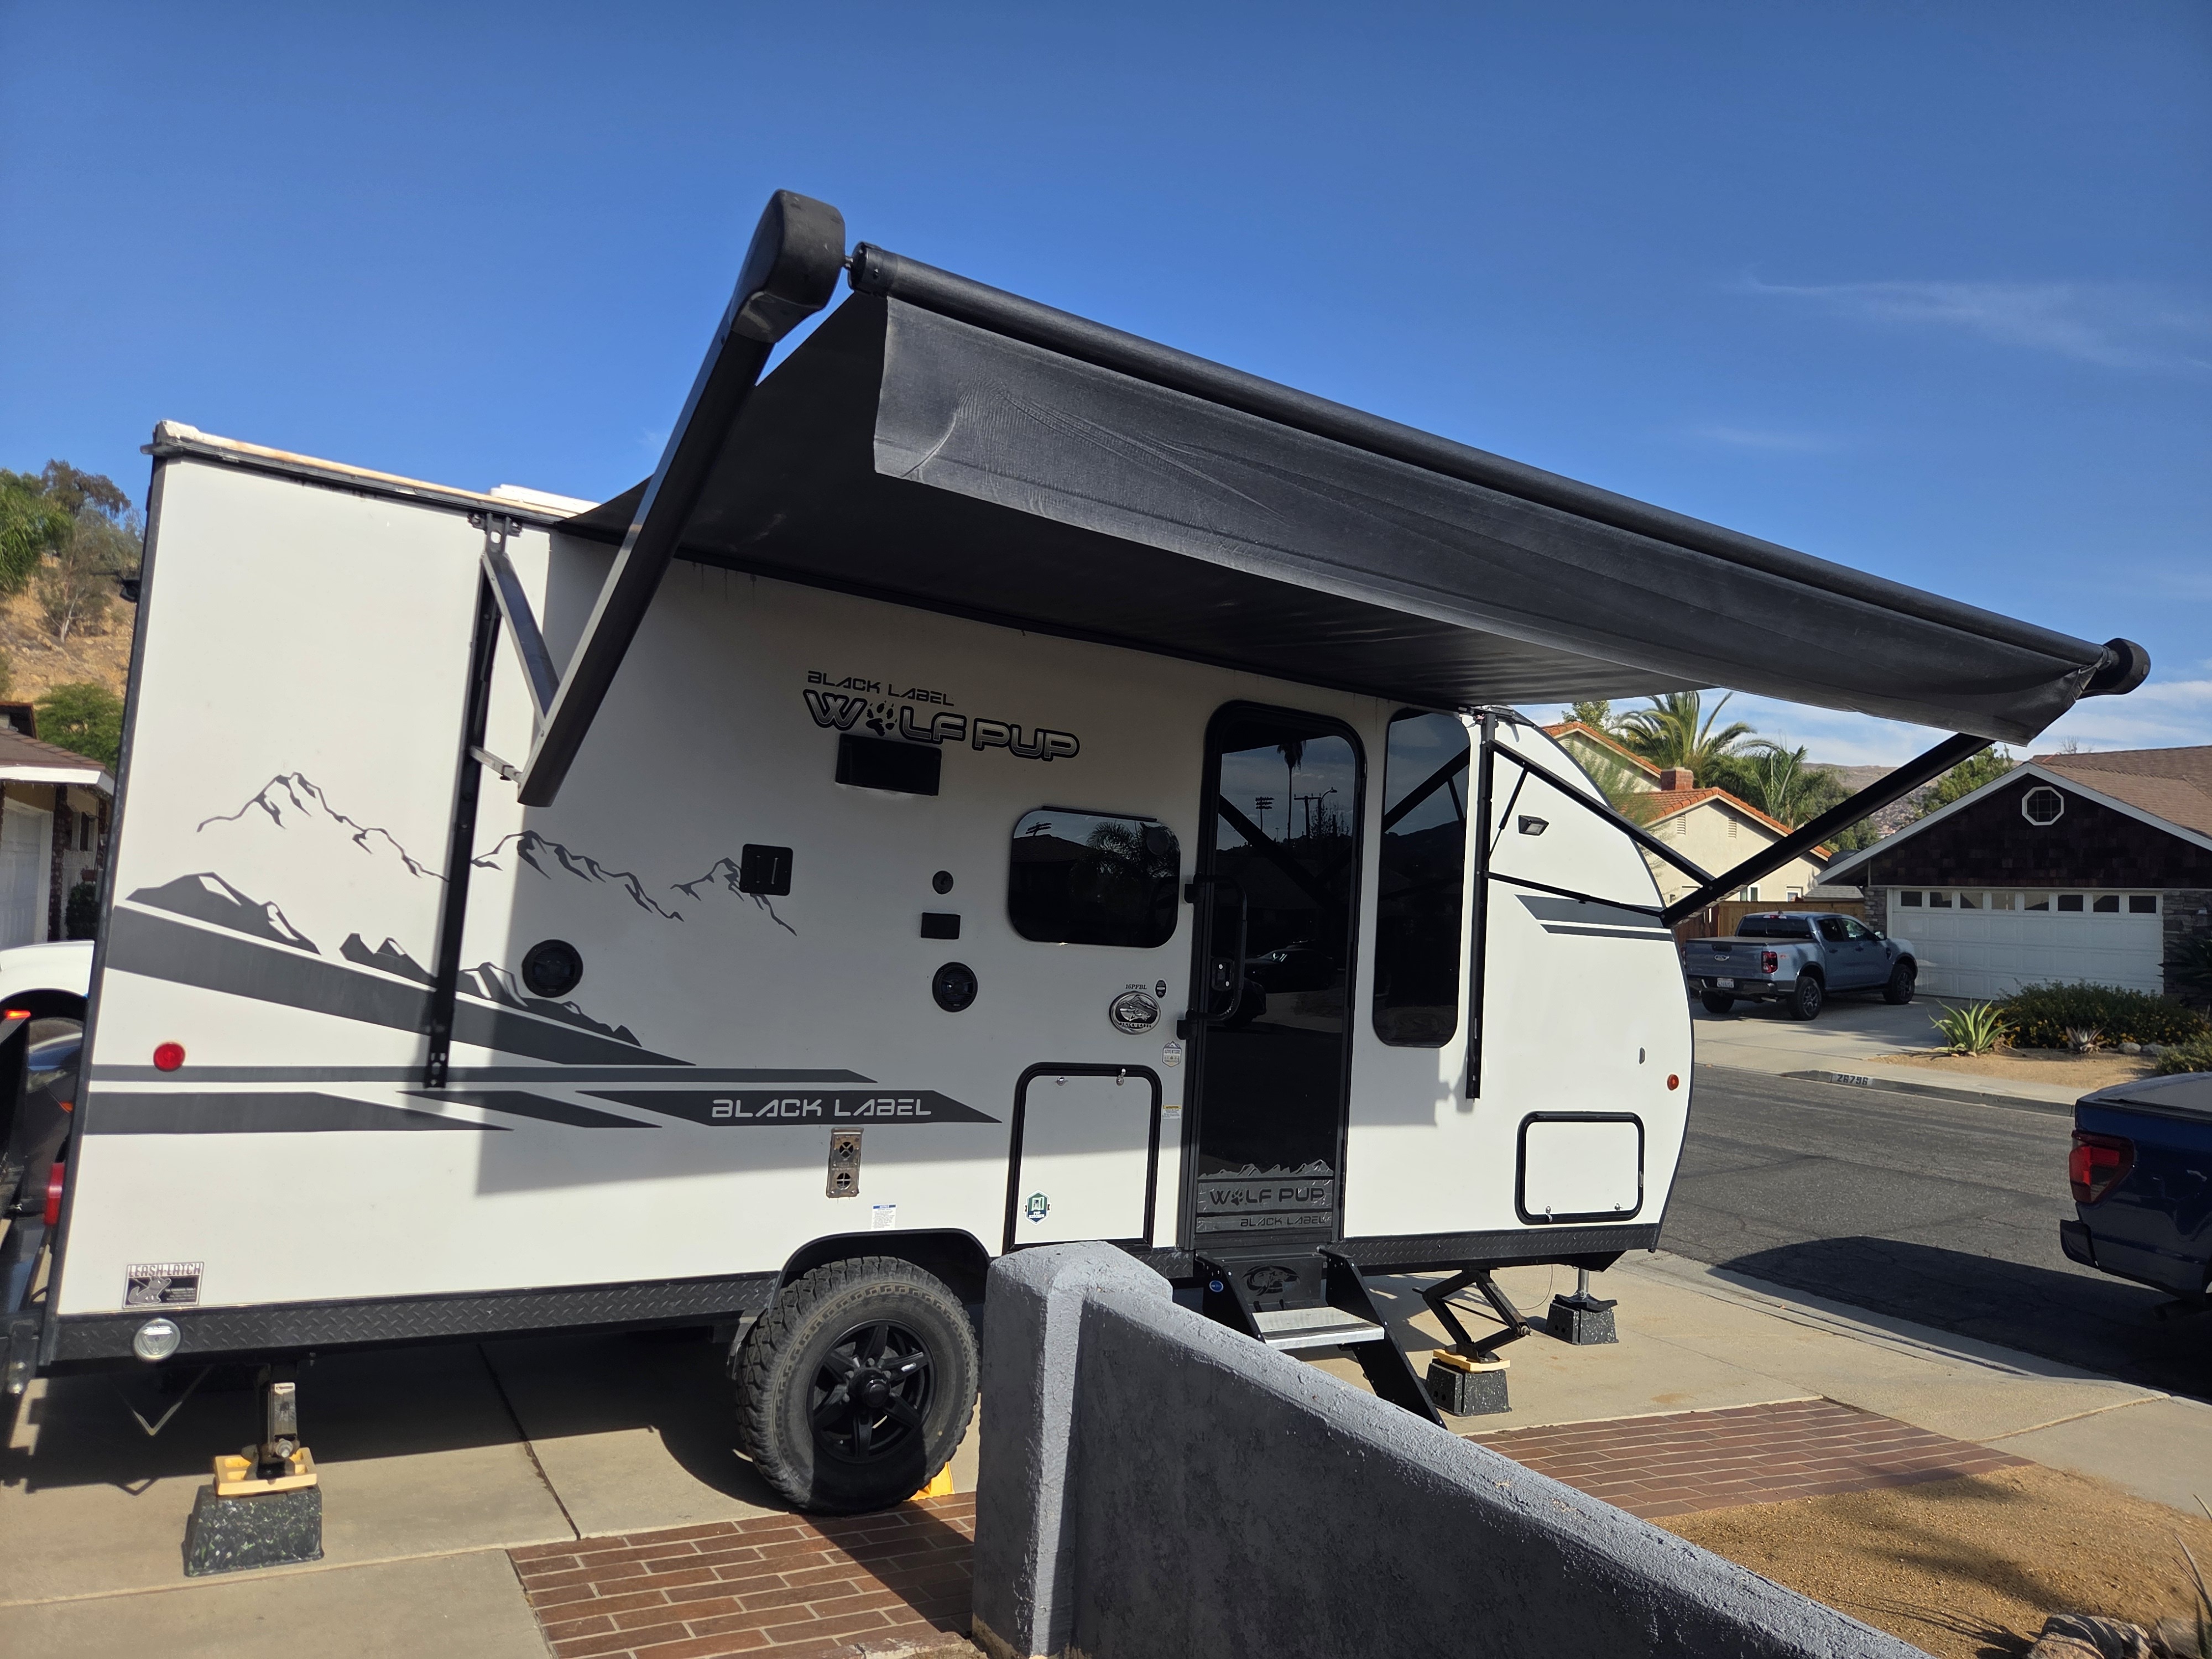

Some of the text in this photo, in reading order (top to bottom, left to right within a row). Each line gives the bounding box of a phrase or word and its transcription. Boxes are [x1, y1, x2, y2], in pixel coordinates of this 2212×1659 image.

[807, 670, 954, 707] BLACK LABEL
[972, 717, 1080, 762] PUP
[712, 1098, 931, 1118] BLACK LABEL
[1279, 1187, 1324, 1202] PUP
[1240, 1215, 1326, 1227] BLACK LABEL
